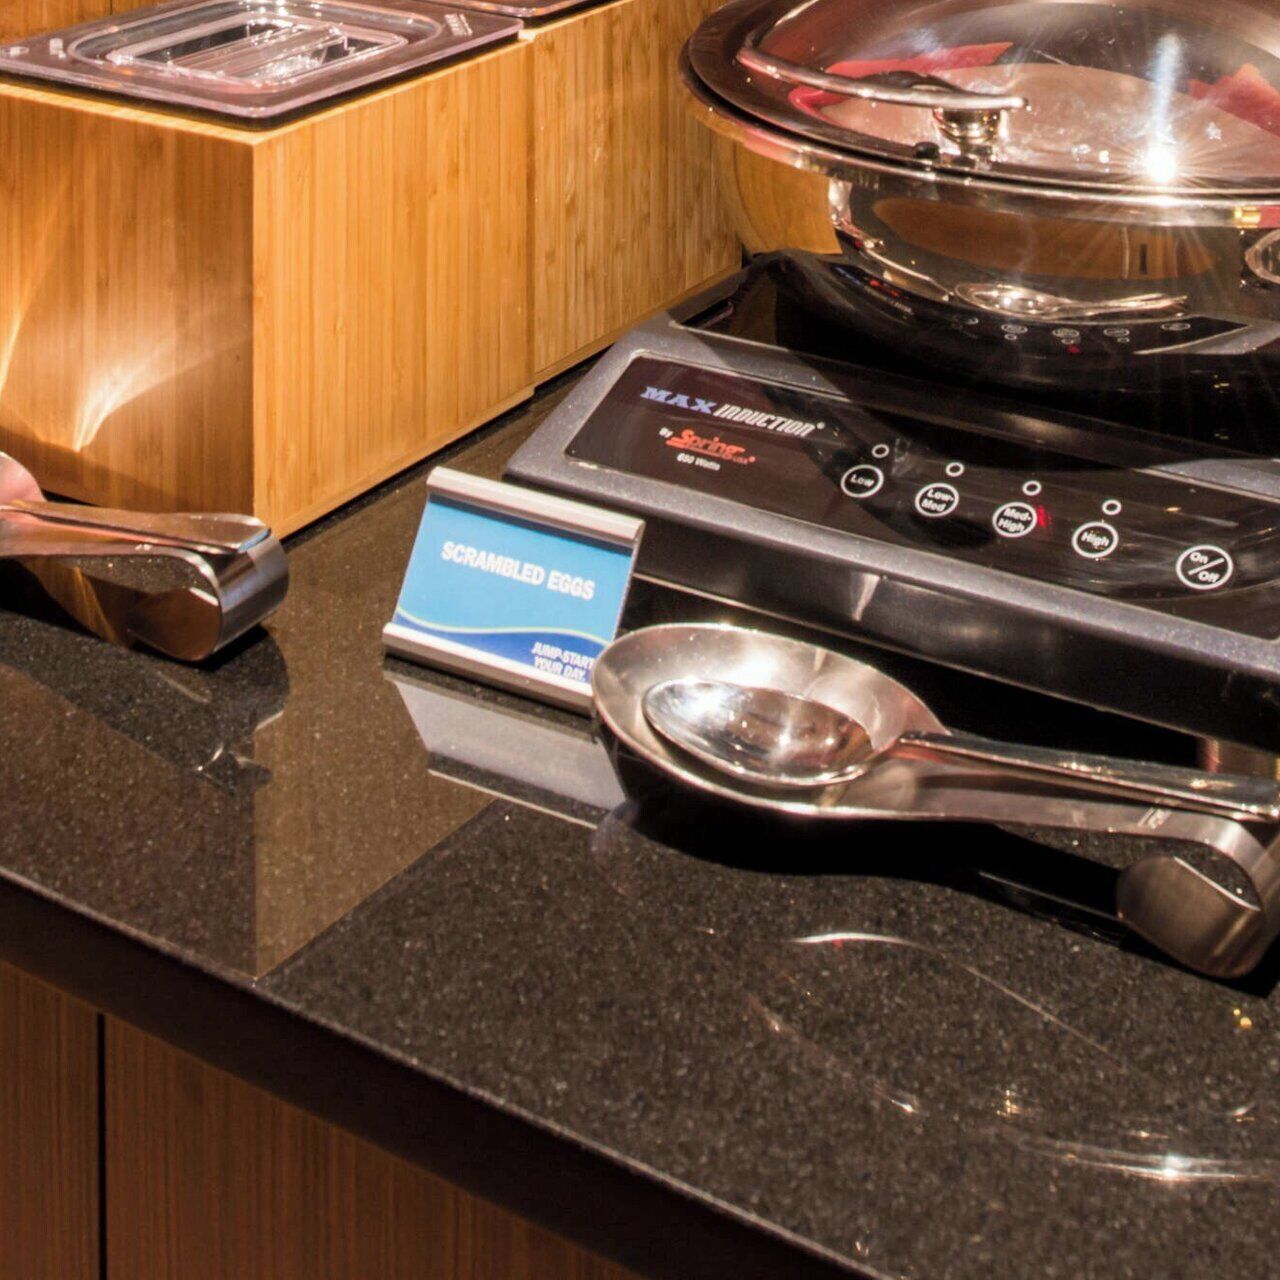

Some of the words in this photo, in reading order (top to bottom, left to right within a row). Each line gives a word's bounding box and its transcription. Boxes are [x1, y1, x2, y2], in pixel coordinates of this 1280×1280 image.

[640, 386, 717, 414] MAX
[659, 426, 674, 438] By
[665, 428, 746, 461] Spring
[695, 456, 721, 471] Watts
[850, 473, 876, 488] Low
[921, 498, 947, 513] Med
[997, 517, 1026, 534] High
[1080, 531, 1110, 548] High
[1189, 551, 1209, 565] On
[440, 540, 546, 587] SCRAMBLED
[546, 569, 597, 602] EGGS
[1197, 569, 1221, 584] Off
[531, 641, 596, 671] JUMP-START
[534, 655, 564, 676] YOUR
